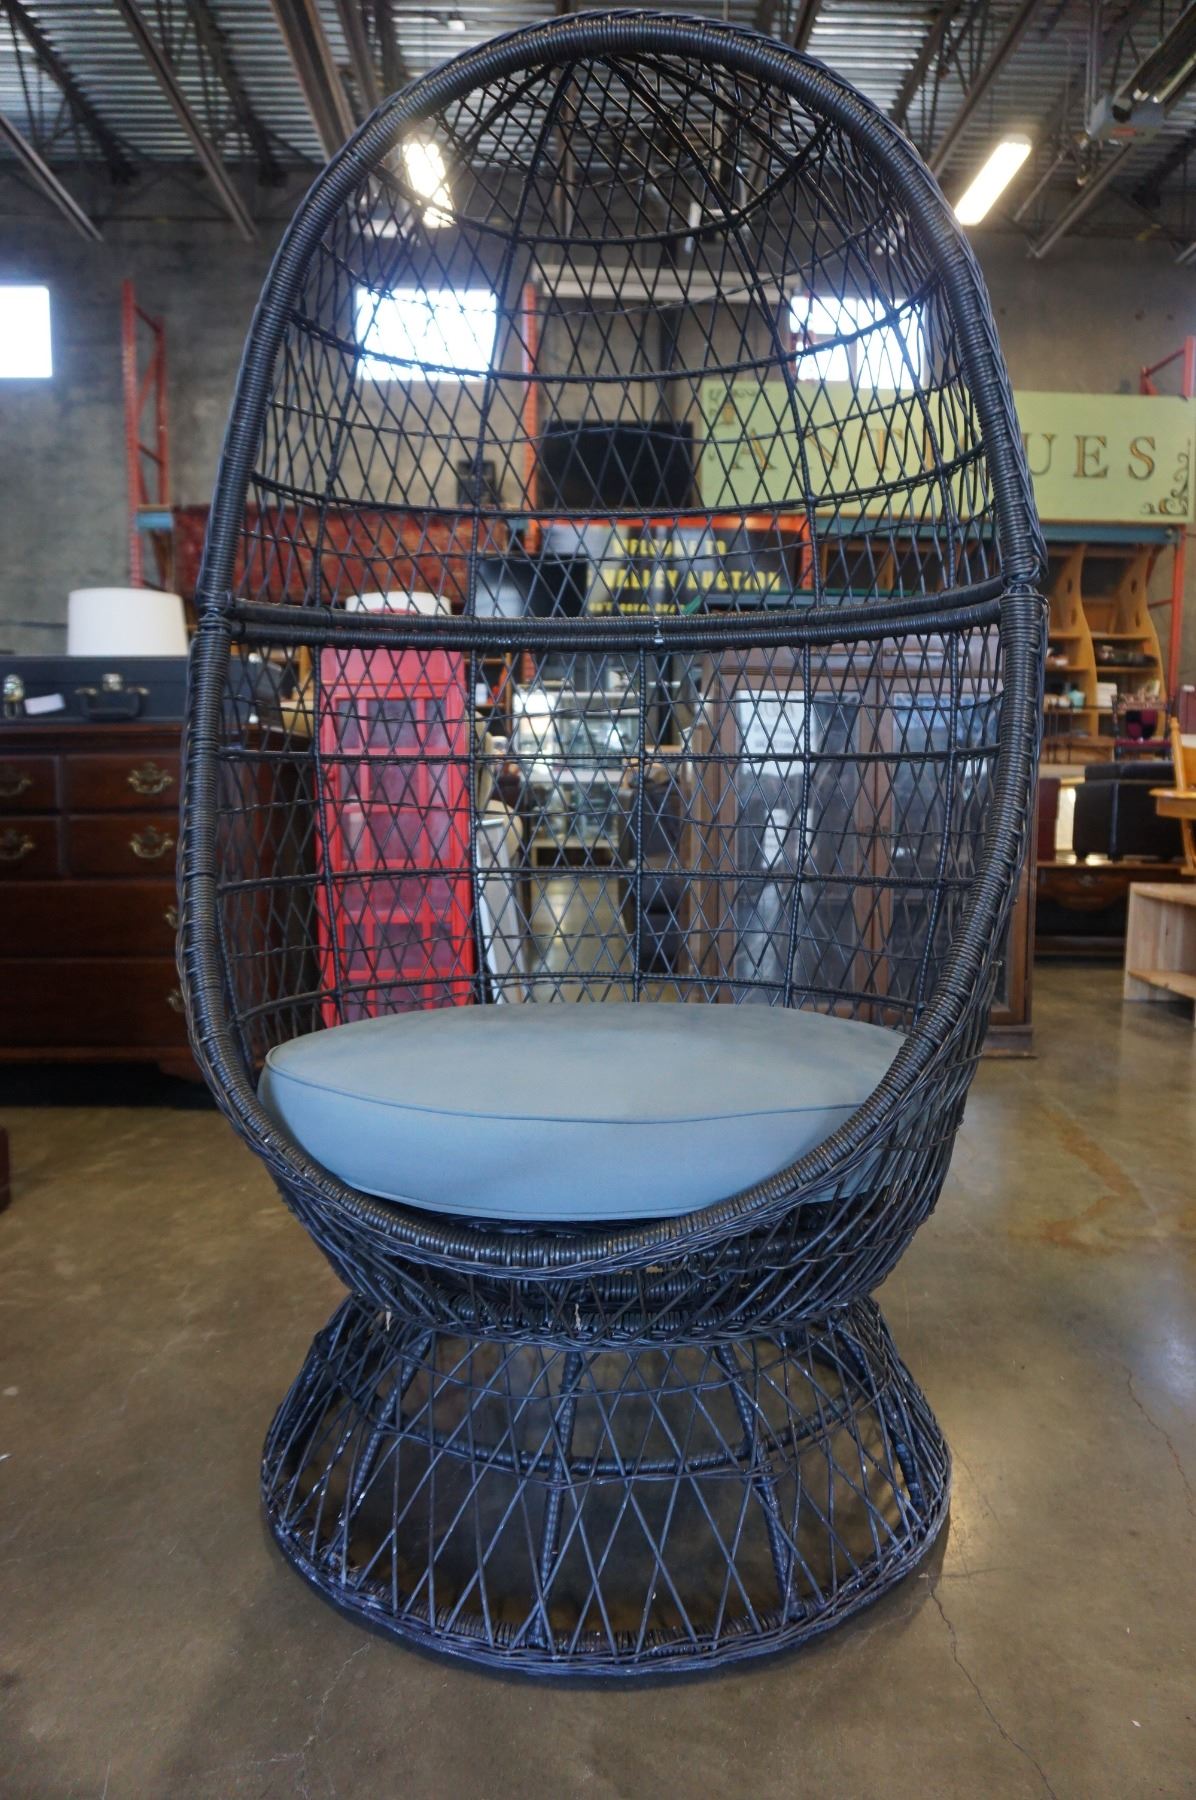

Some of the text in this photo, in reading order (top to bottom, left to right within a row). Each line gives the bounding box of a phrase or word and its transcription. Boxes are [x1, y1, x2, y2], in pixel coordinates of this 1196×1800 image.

[731, 427, 1156, 481] ANTIUES
[602, 568, 678, 590] VALLEY
[687, 570, 780, 591] AUCTION
